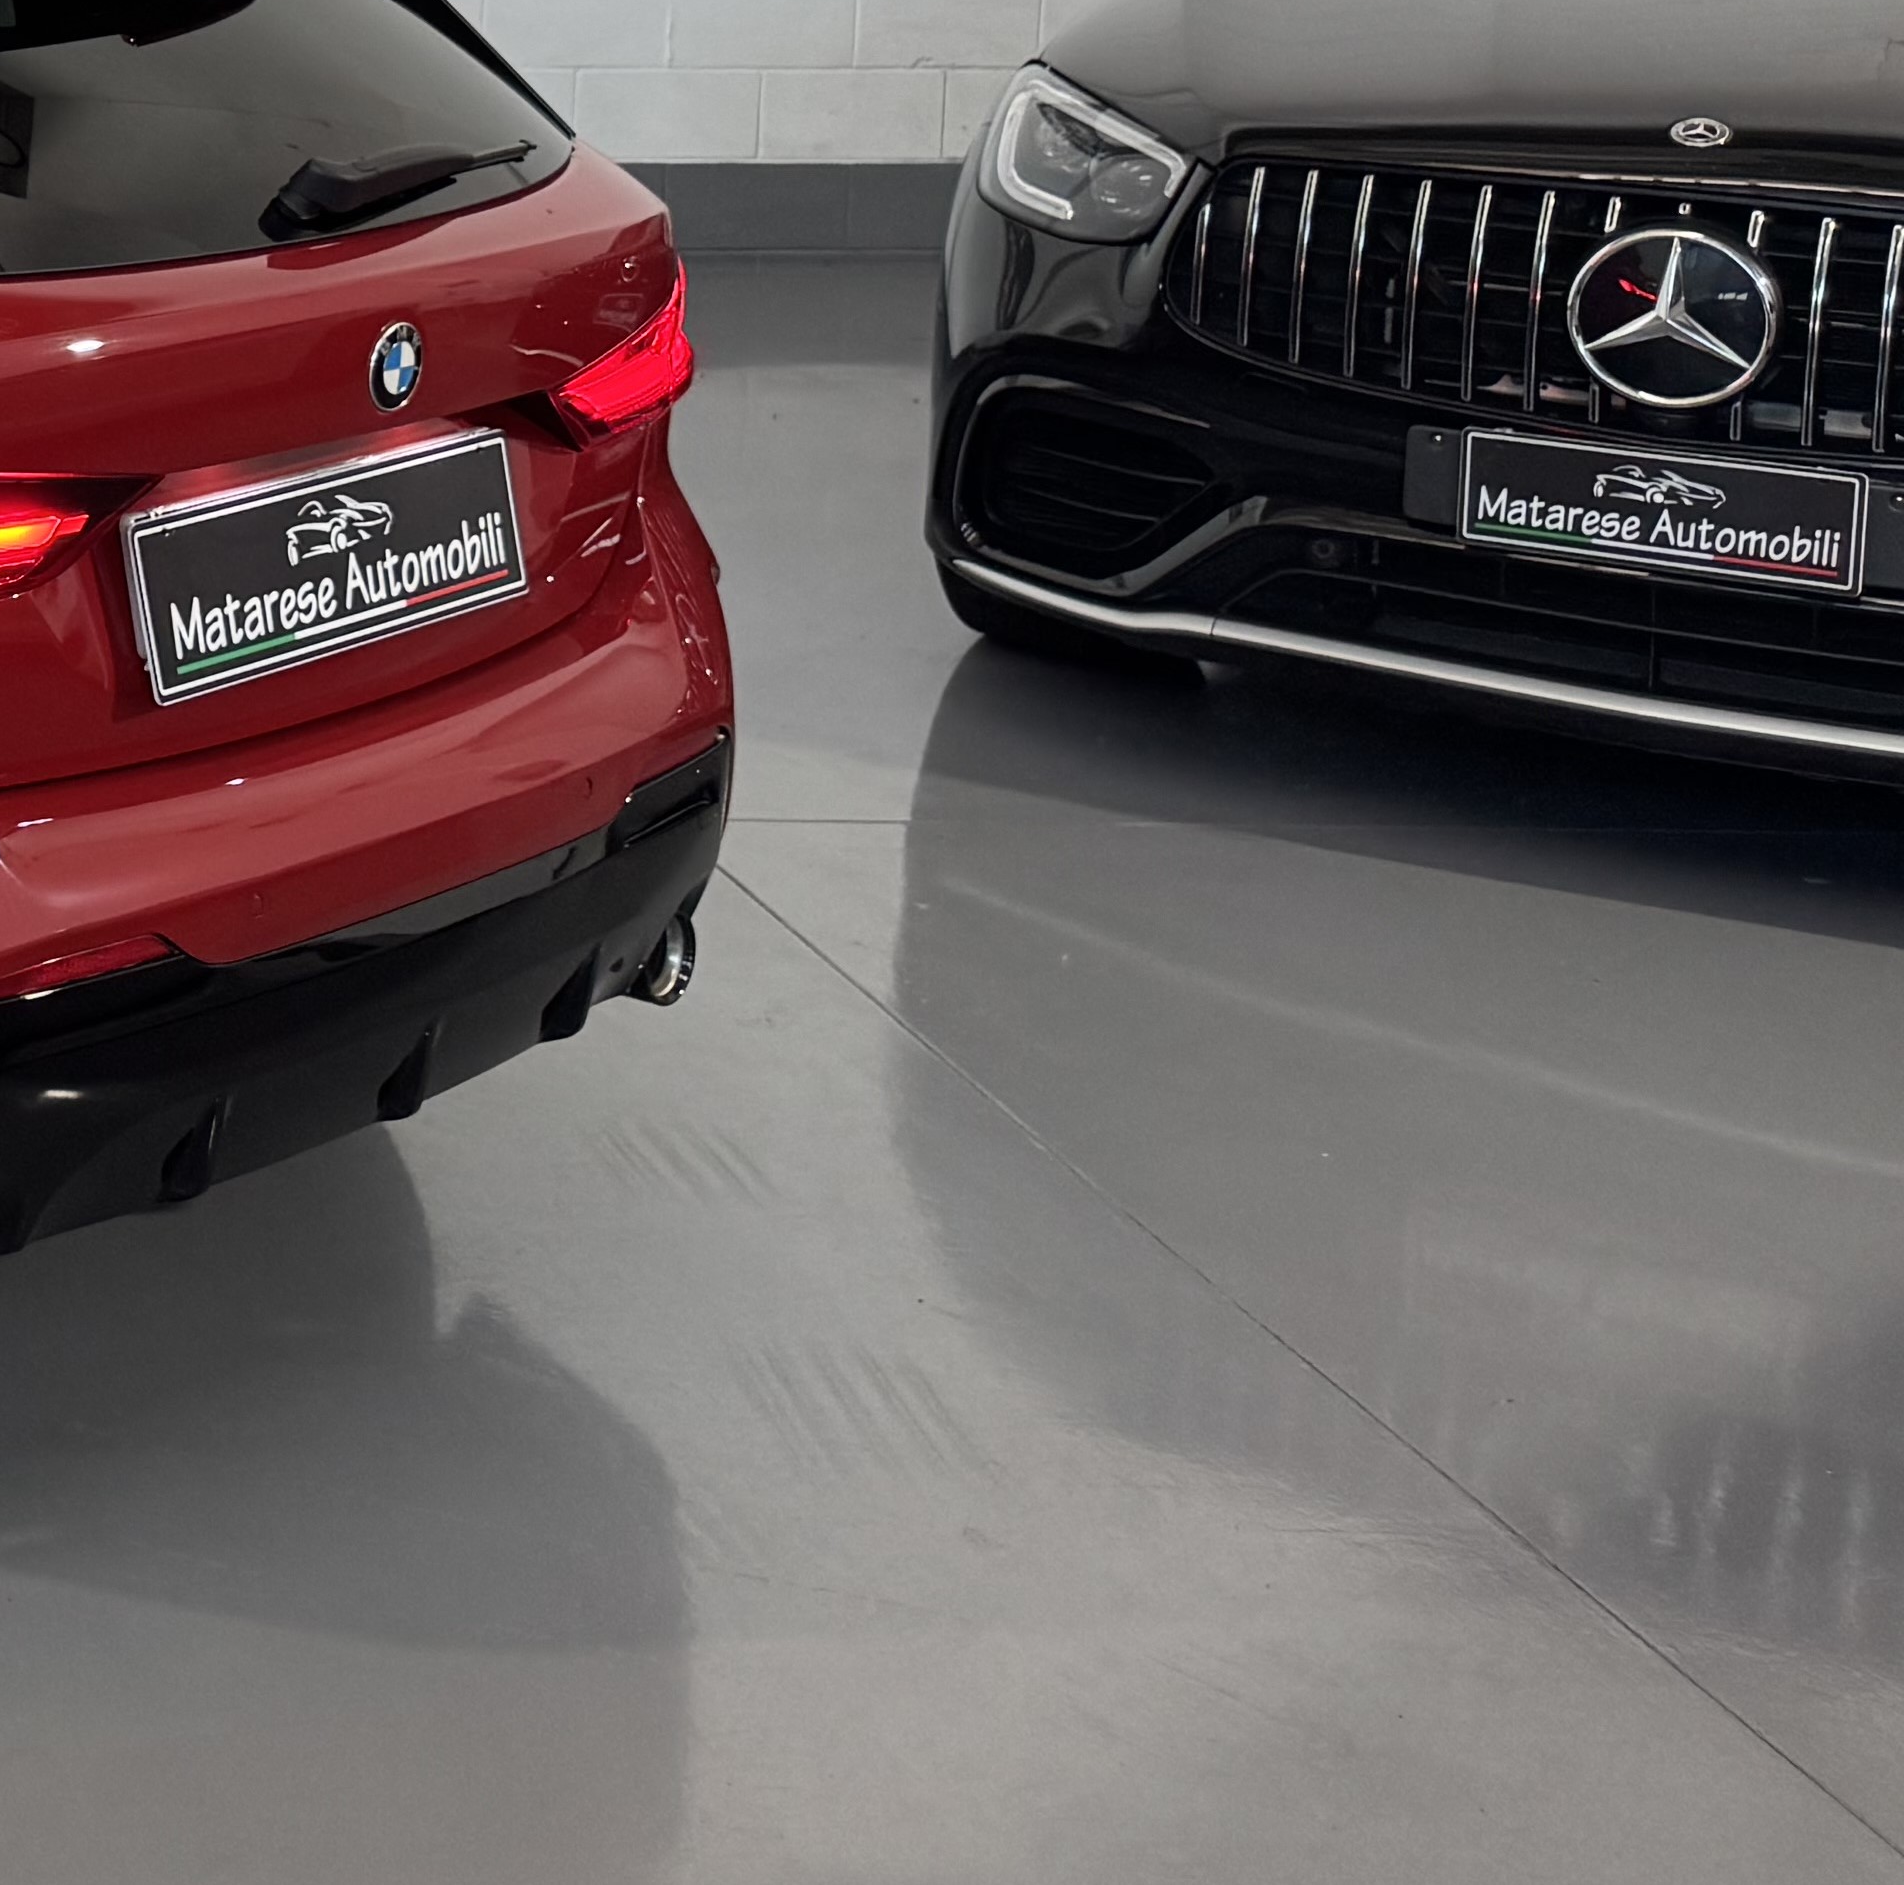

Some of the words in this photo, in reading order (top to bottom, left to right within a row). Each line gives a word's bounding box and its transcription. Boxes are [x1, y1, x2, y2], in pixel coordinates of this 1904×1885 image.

[1476, 483, 1642, 542] Matarese
[1648, 507, 1842, 569] Automobili
[169, 576, 339, 661] Matarese
[344, 511, 507, 611] Automobili
